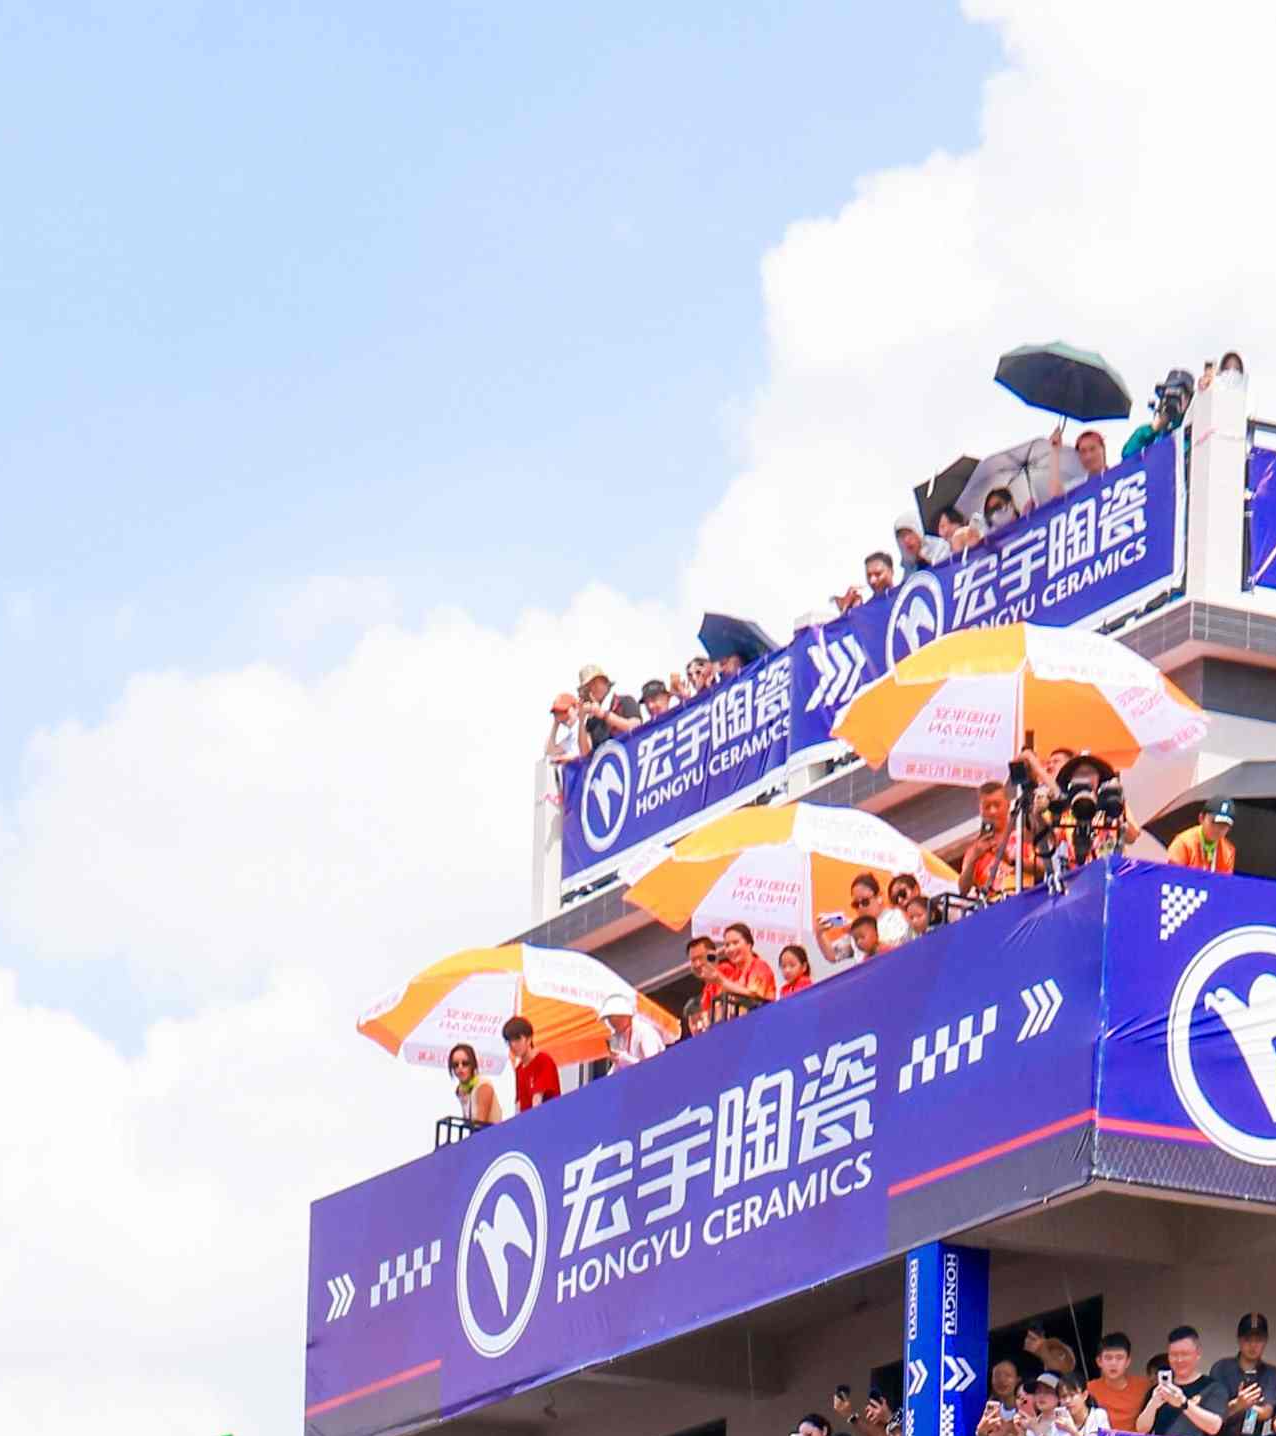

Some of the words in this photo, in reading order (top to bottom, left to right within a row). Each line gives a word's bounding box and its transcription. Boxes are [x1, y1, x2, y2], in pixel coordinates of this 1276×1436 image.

[953, 471, 1148, 629] 宏宇陶瓷
[963, 594, 1037, 632] ONGYU
[1042, 536, 1148, 609] CERAMICS
[634, 763, 707, 819] HONGYU
[708, 717, 793, 777] CERAMICS
[637, 658, 792, 793] 宏宇陶瓷
[561, 1033, 878, 1258] 宏宇陶瓷
[556, 1221, 692, 1305] HONGYU
[702, 1152, 873, 1251] CERAMICS
[907, 1258, 919, 1341] HONGYU
[944, 1253, 958, 1336] HONGYU
